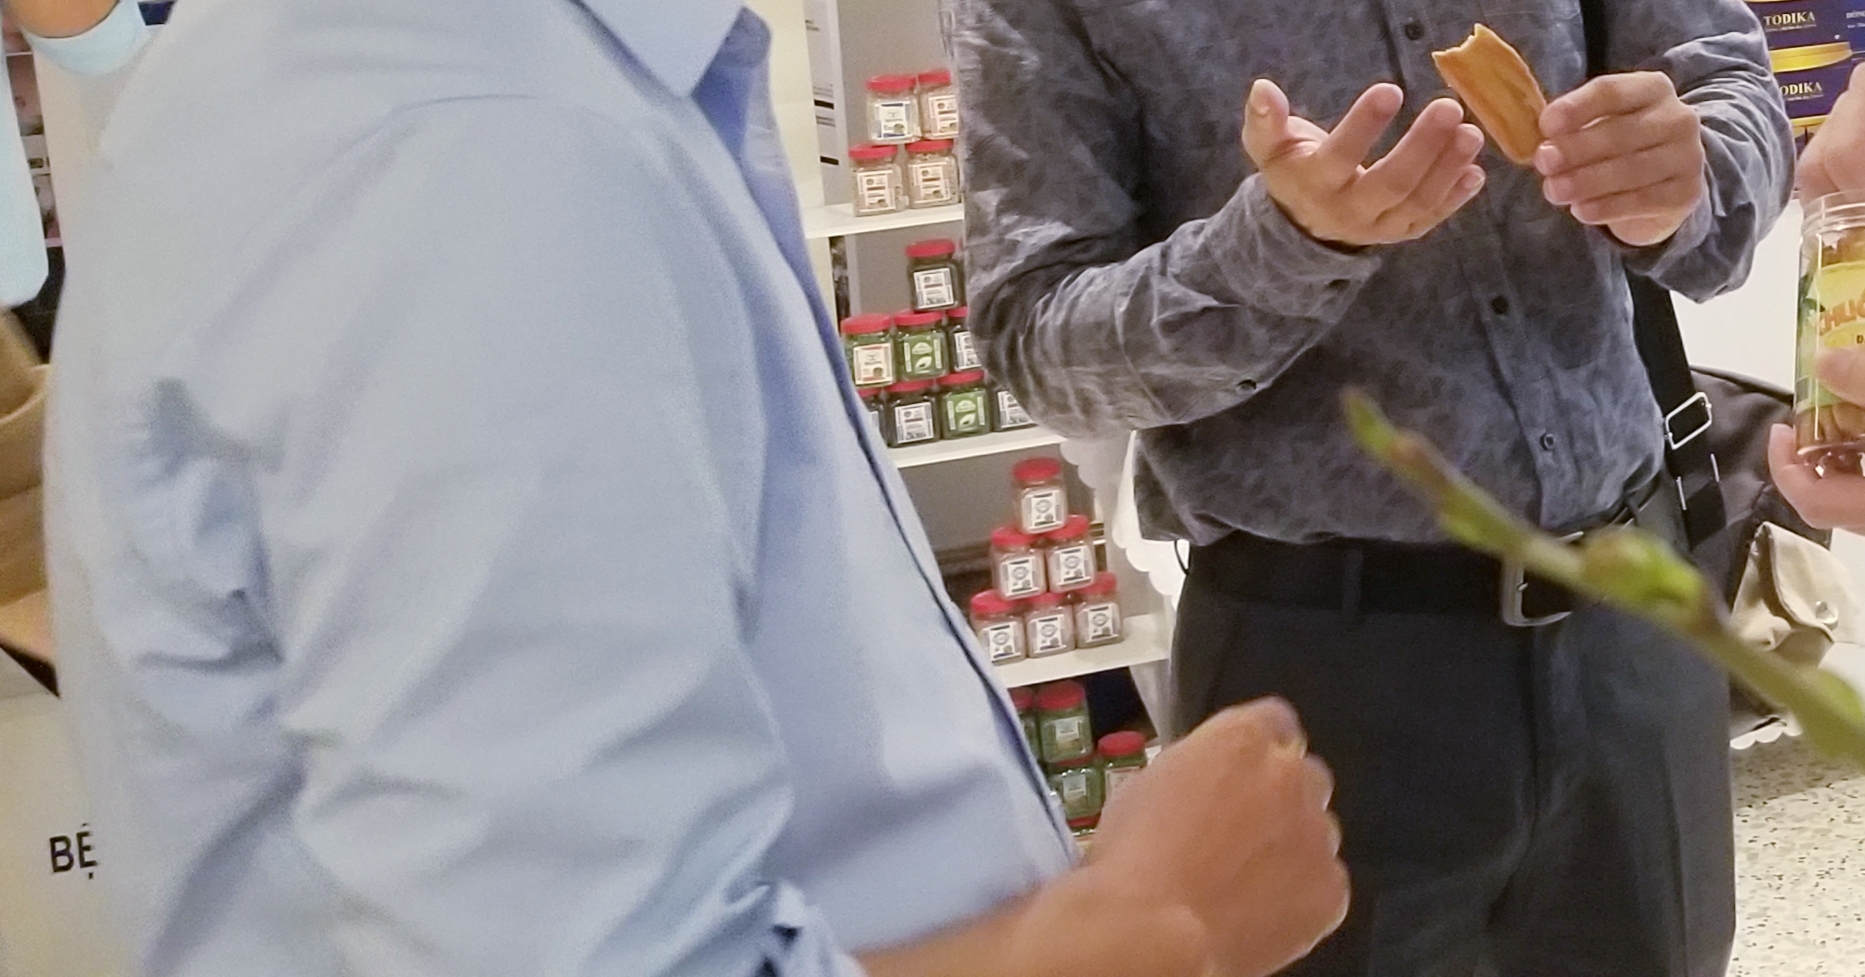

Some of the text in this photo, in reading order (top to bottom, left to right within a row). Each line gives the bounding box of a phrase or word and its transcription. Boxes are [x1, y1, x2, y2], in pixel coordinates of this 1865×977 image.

[1763, 10, 1816, 26] TODIKA
[1780, 81, 1823, 97] ODIKA
[49, 823, 98, 880] BỆ
